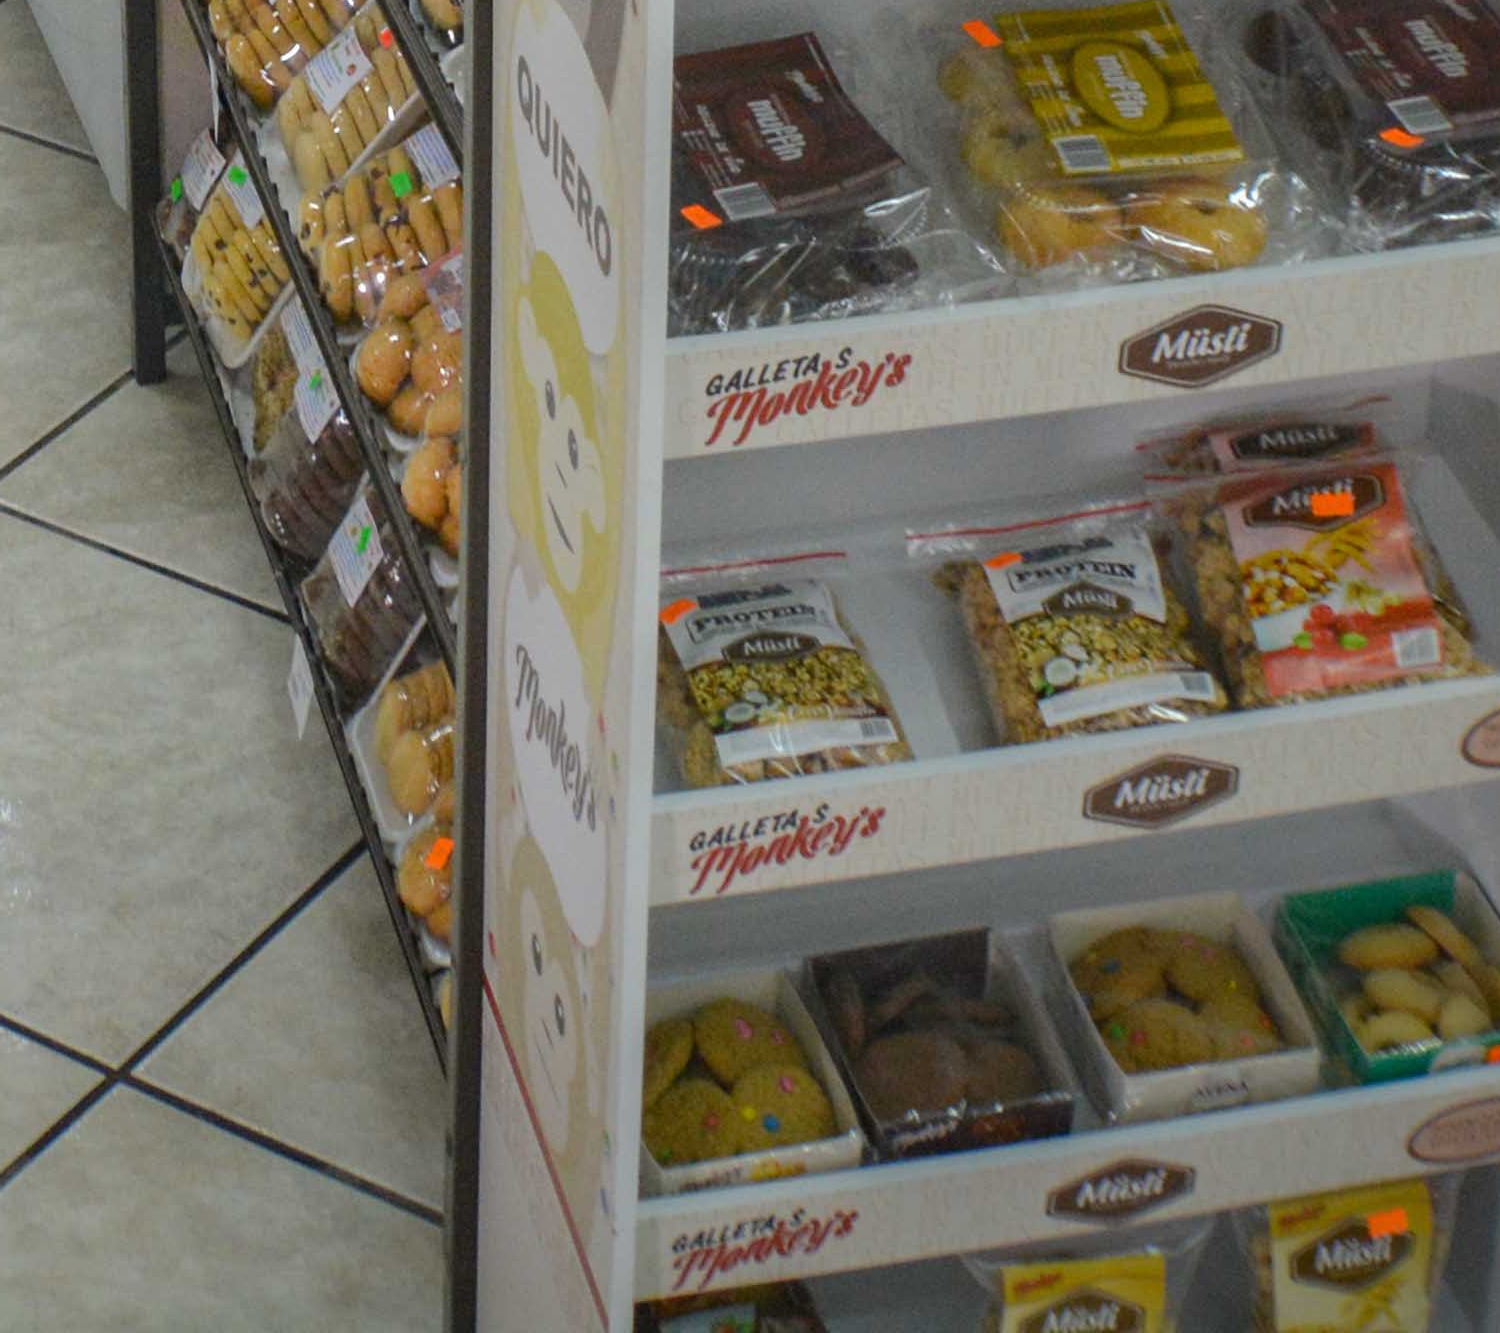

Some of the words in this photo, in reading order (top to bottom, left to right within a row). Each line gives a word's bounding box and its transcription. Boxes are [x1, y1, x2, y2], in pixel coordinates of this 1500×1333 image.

[1093, 53, 1149, 120] muffin
[516, 51, 614, 281] QUIERO
[1152, 322, 1250, 364] Müsli
[705, 345, 853, 399] GALLETAS
[705, 352, 912, 447] Monkey's
[1260, 425, 1344, 454] Müsli
[1014, 560, 1138, 589] PROTEIN
[689, 600, 819, 638] PROTEIN
[1061, 589, 1120, 615] Müsli
[1114, 767, 1210, 811] Müsli
[689, 802, 831, 852] GALLETAS
[689, 805, 887, 894] Monkey's
[1075, 1168, 1167, 1208] Müsli
[672, 1210, 860, 1291] Monkey's
[1314, 1235, 1393, 1274] Müsli
